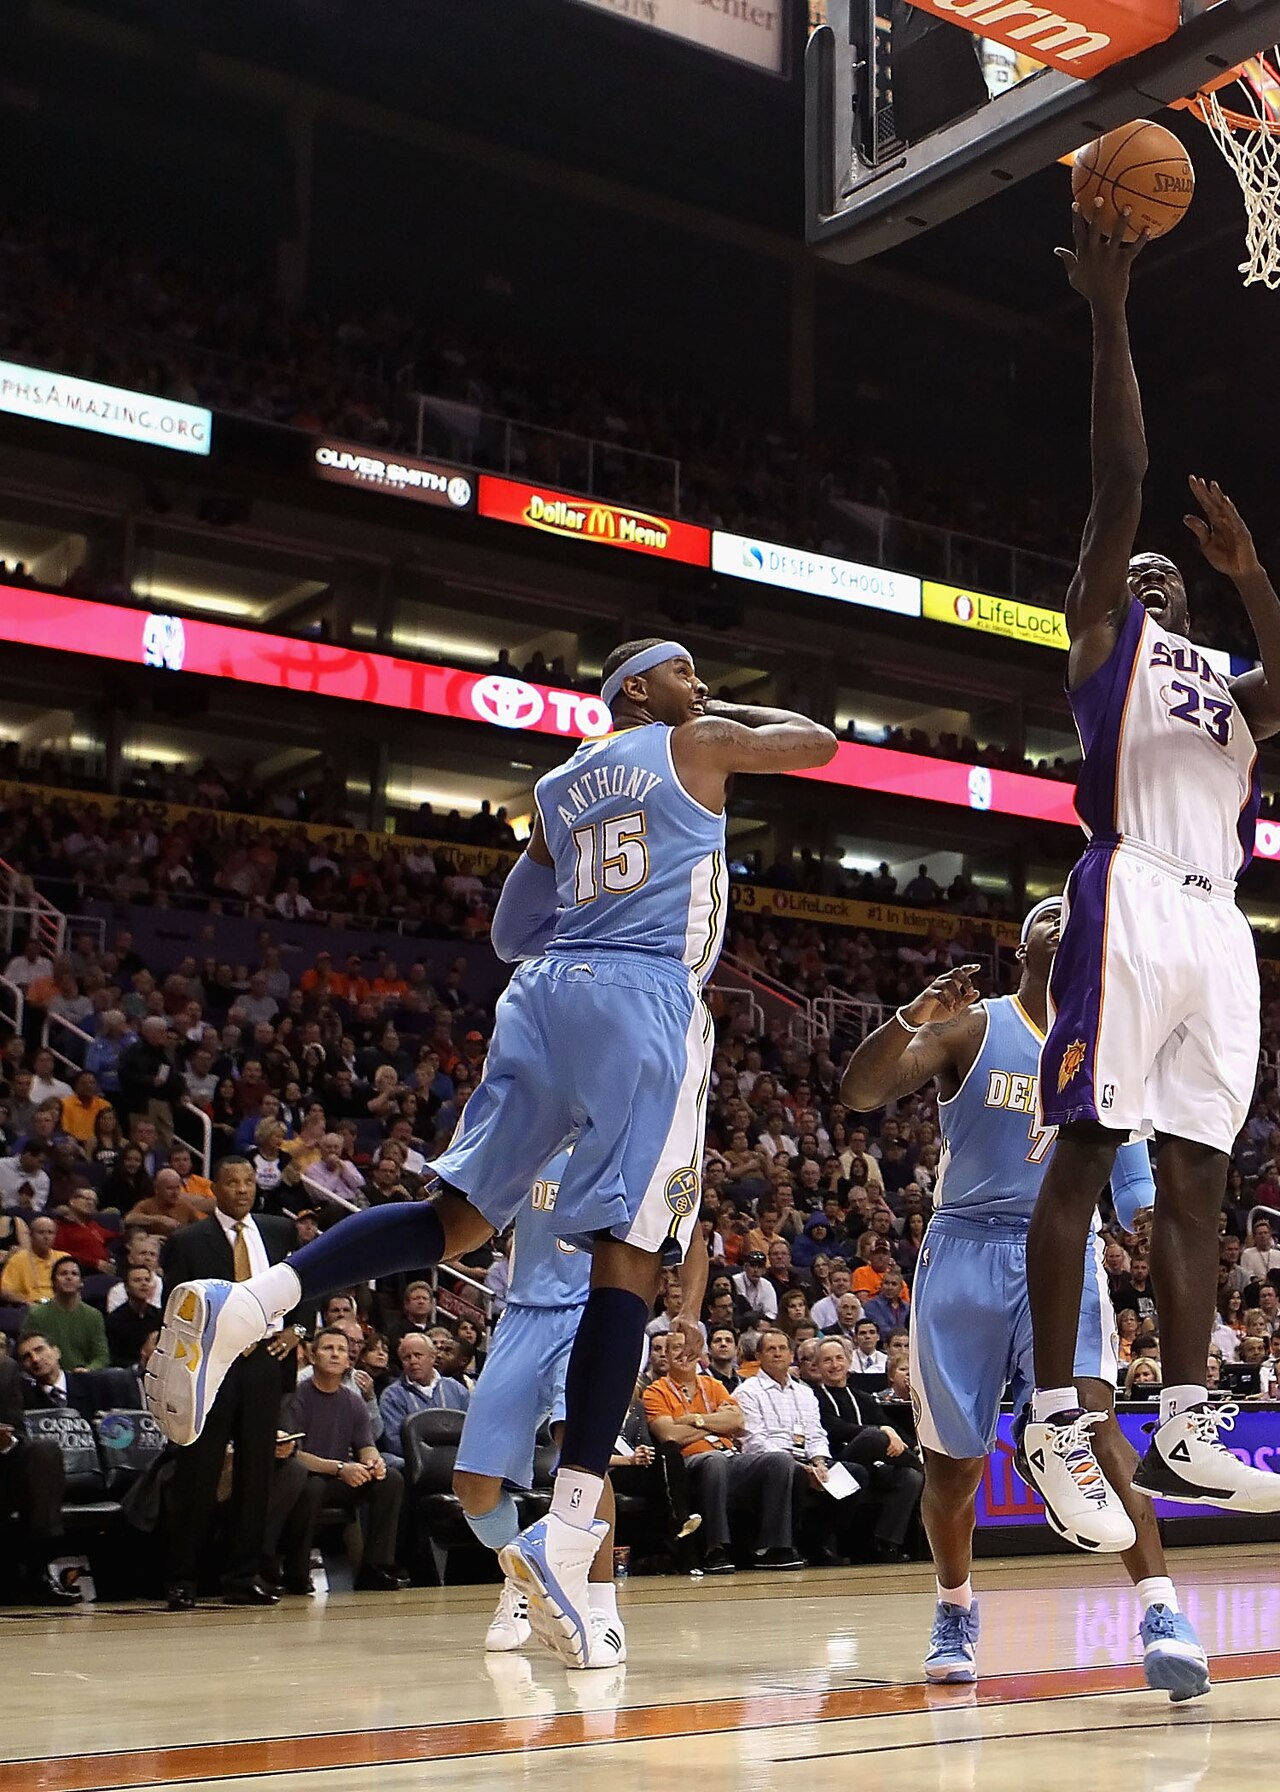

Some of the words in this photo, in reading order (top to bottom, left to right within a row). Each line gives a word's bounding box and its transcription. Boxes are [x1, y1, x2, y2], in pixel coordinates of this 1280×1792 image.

[315, 447, 386, 478] OLIVER
[386, 463, 448, 493] SMITH
[530, 495, 586, 530] Dollar
[619, 516, 667, 549] Menu
[830, 565, 896, 598] SCHOOLS
[977, 598, 1063, 638] LifeLock
[1168, 680, 1234, 746] 23
[557, 764, 663, 829] ANTHONY
[572, 809, 650, 906] 15
[789, 893, 849, 917] LifeLock
[867, 906, 882, 923] #1
[887, 908, 900, 924] In
[1024, 1119, 1059, 1164] 7
[40, 1417, 92, 1433] CASINO
